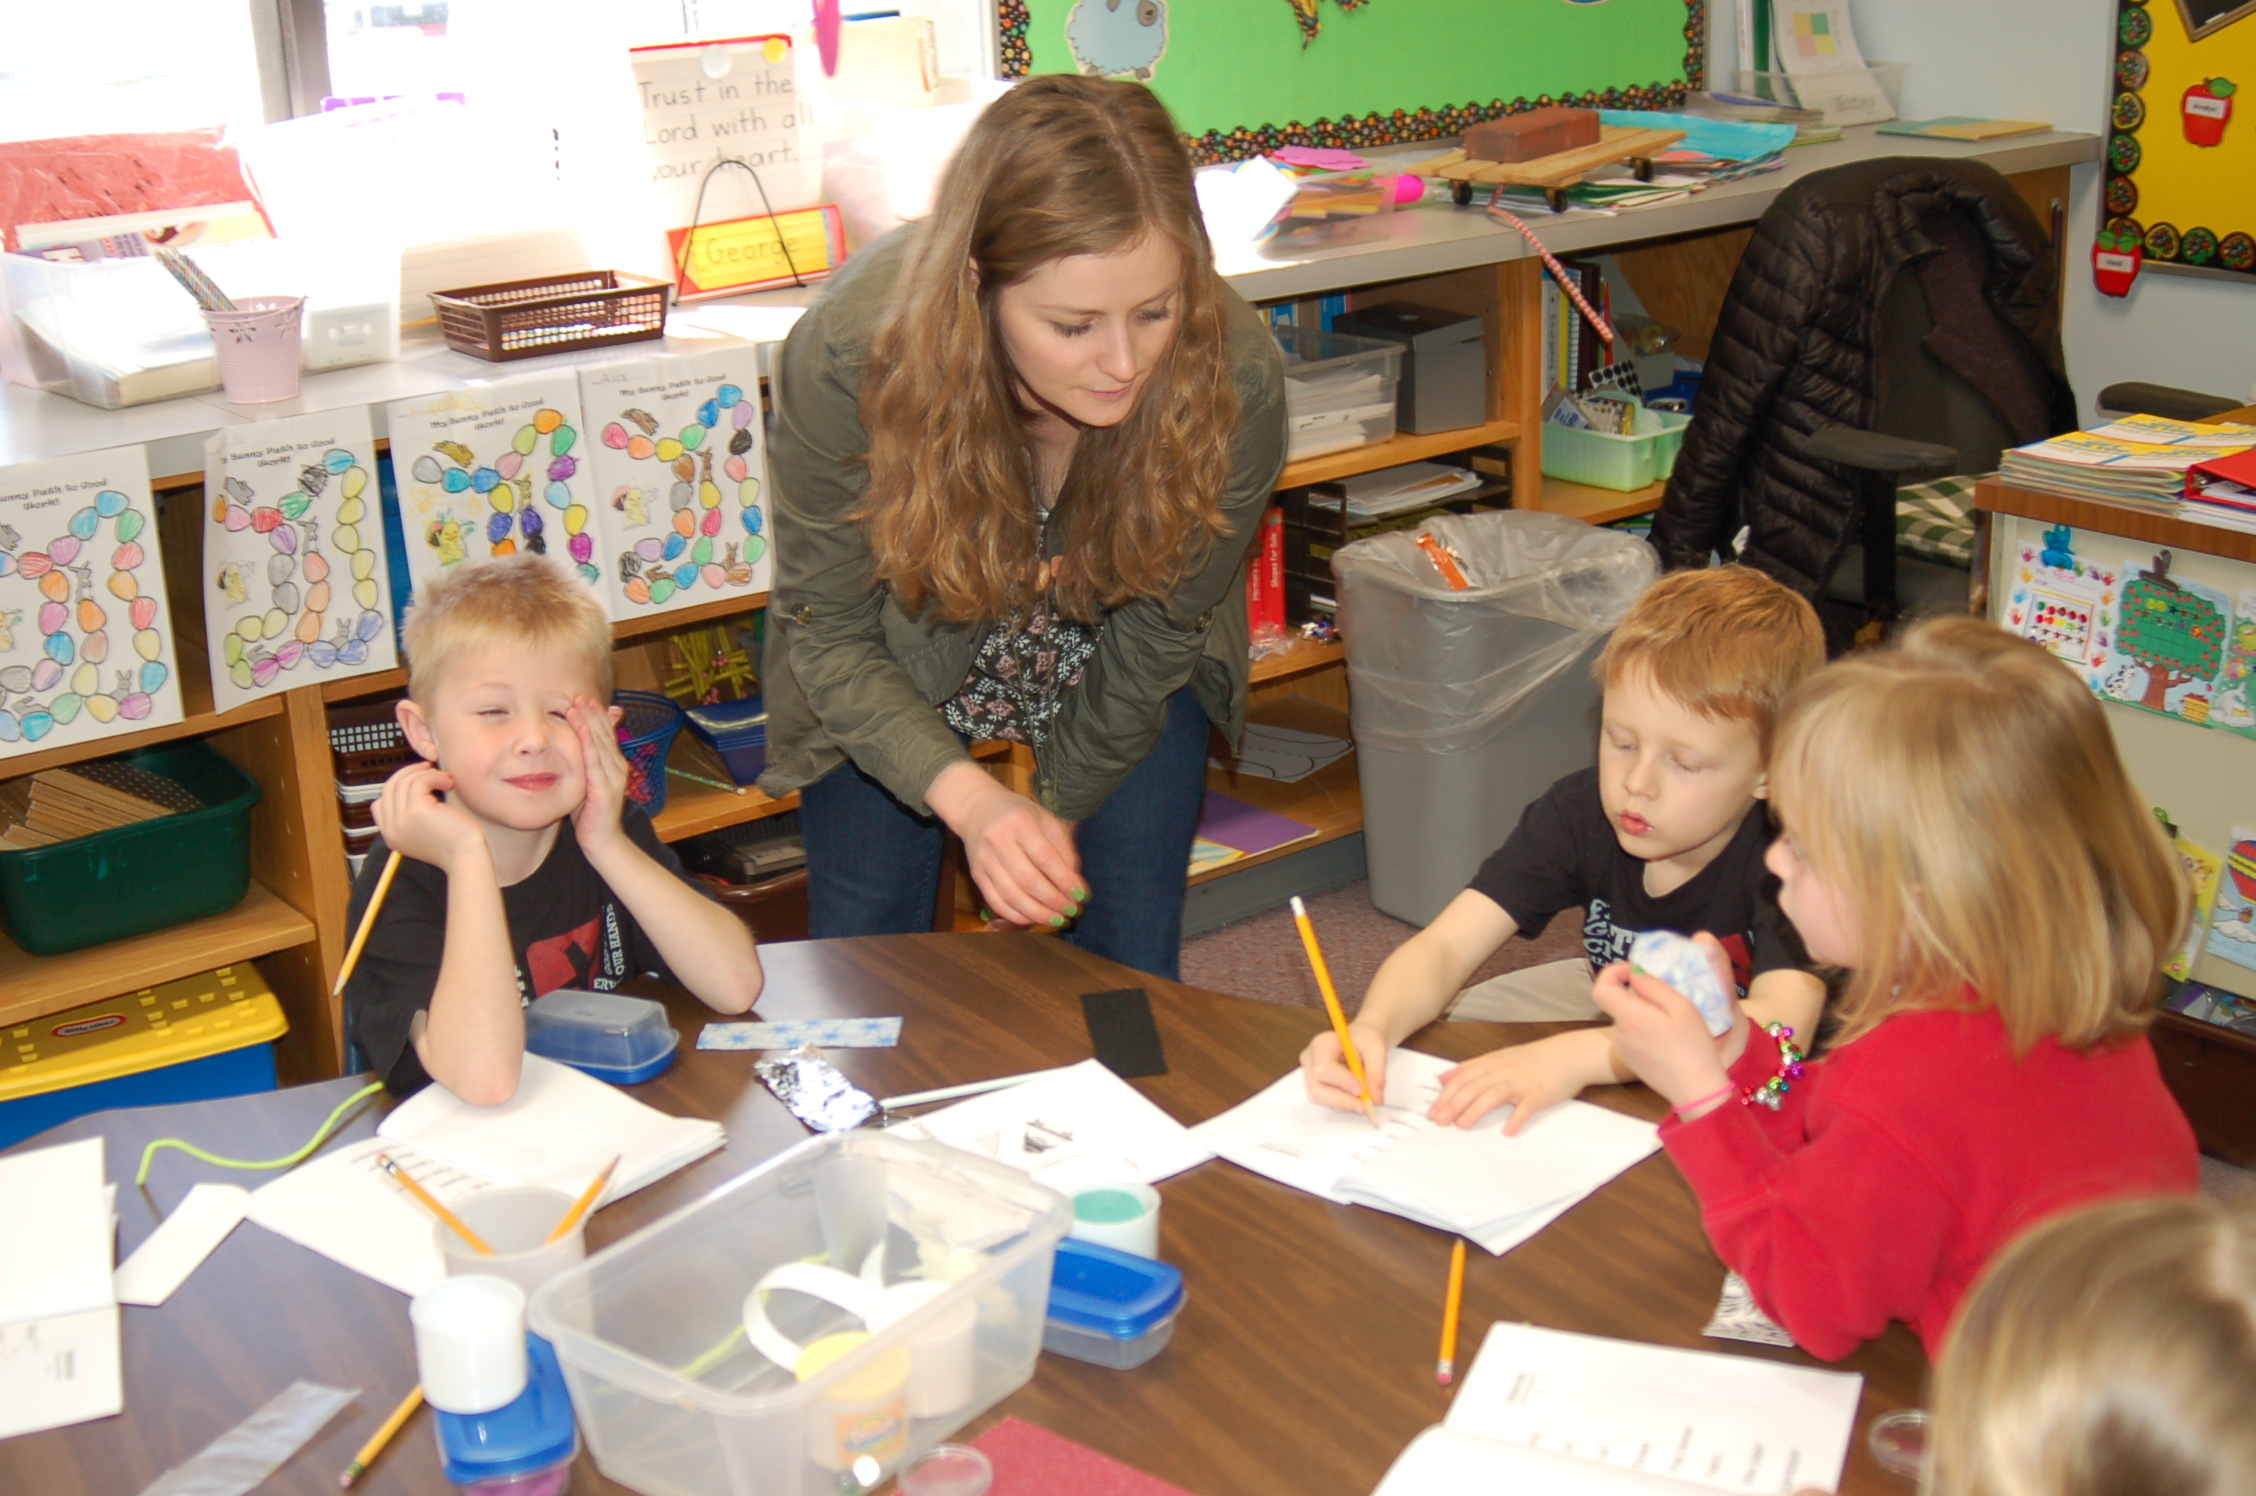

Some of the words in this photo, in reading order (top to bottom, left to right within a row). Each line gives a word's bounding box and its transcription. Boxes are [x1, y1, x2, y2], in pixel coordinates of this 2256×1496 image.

[639, 80, 706, 108] Trust
[718, 79, 739, 100] in
[753, 70, 793, 95] the
[711, 108, 767, 136] with
[781, 101, 814, 128] all
[716, 138, 800, 170] heart.
[705, 237, 800, 264] George
[448, 414, 479, 425] Bunny
[521, 398, 545, 409] Good
[230, 450, 263, 461] Bunny
[310, 437, 336, 449] Good
[0, 492, 28, 503] unny
[80, 479, 107, 490] Good
[1269, 532, 1278, 548] Sale
[1269, 547, 1278, 562] for
[1270, 562, 1279, 588] Shapes
[606, 903, 621, 950] HANDS
[611, 948, 625, 976] OUR
